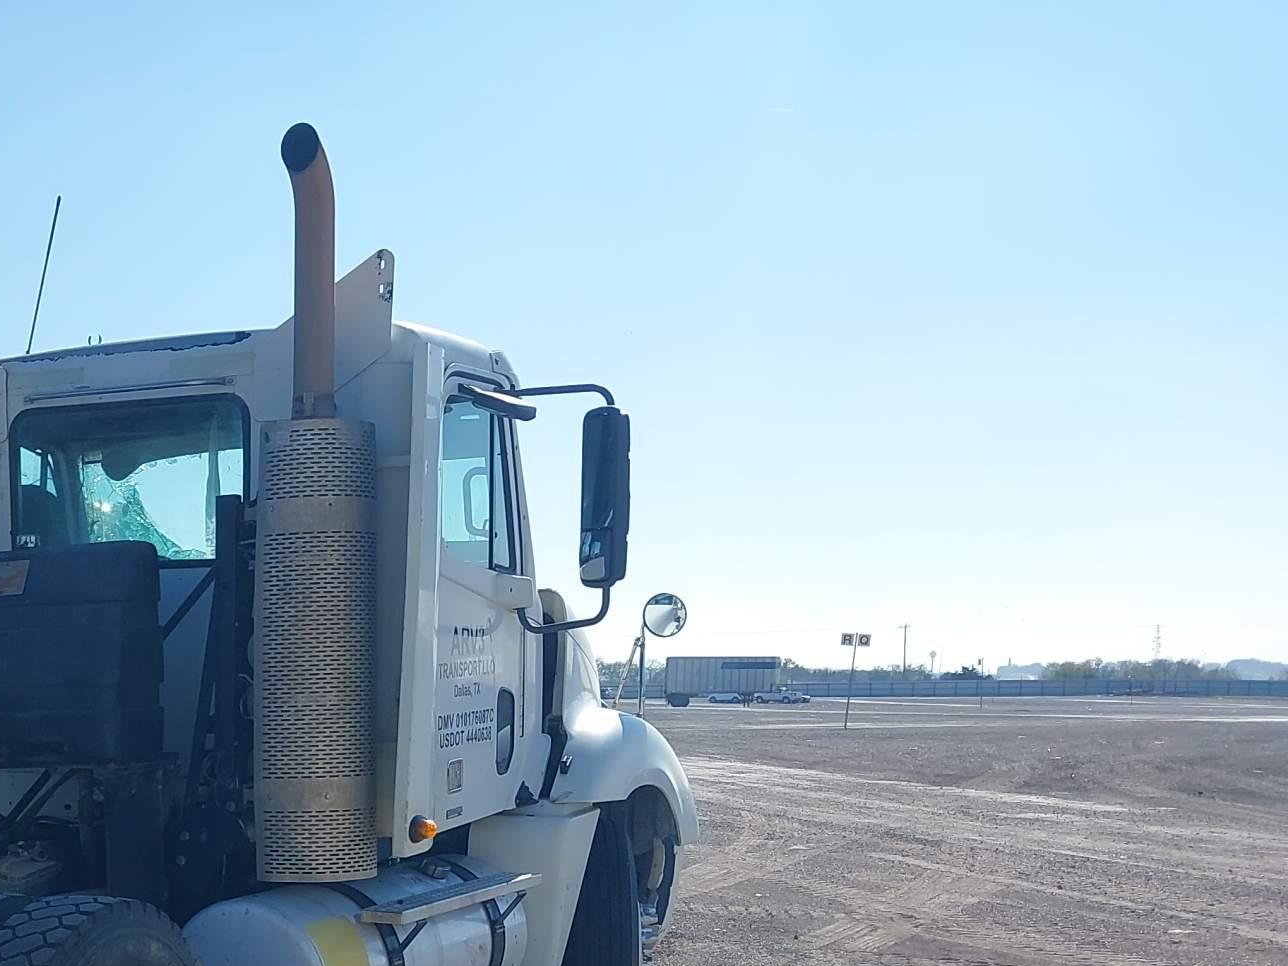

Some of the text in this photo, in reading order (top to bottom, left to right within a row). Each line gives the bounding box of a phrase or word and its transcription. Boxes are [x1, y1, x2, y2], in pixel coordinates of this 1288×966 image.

[473, 682, 481, 696] TX
[438, 712, 455, 731] DMV
[440, 730, 465, 749] USDOT
